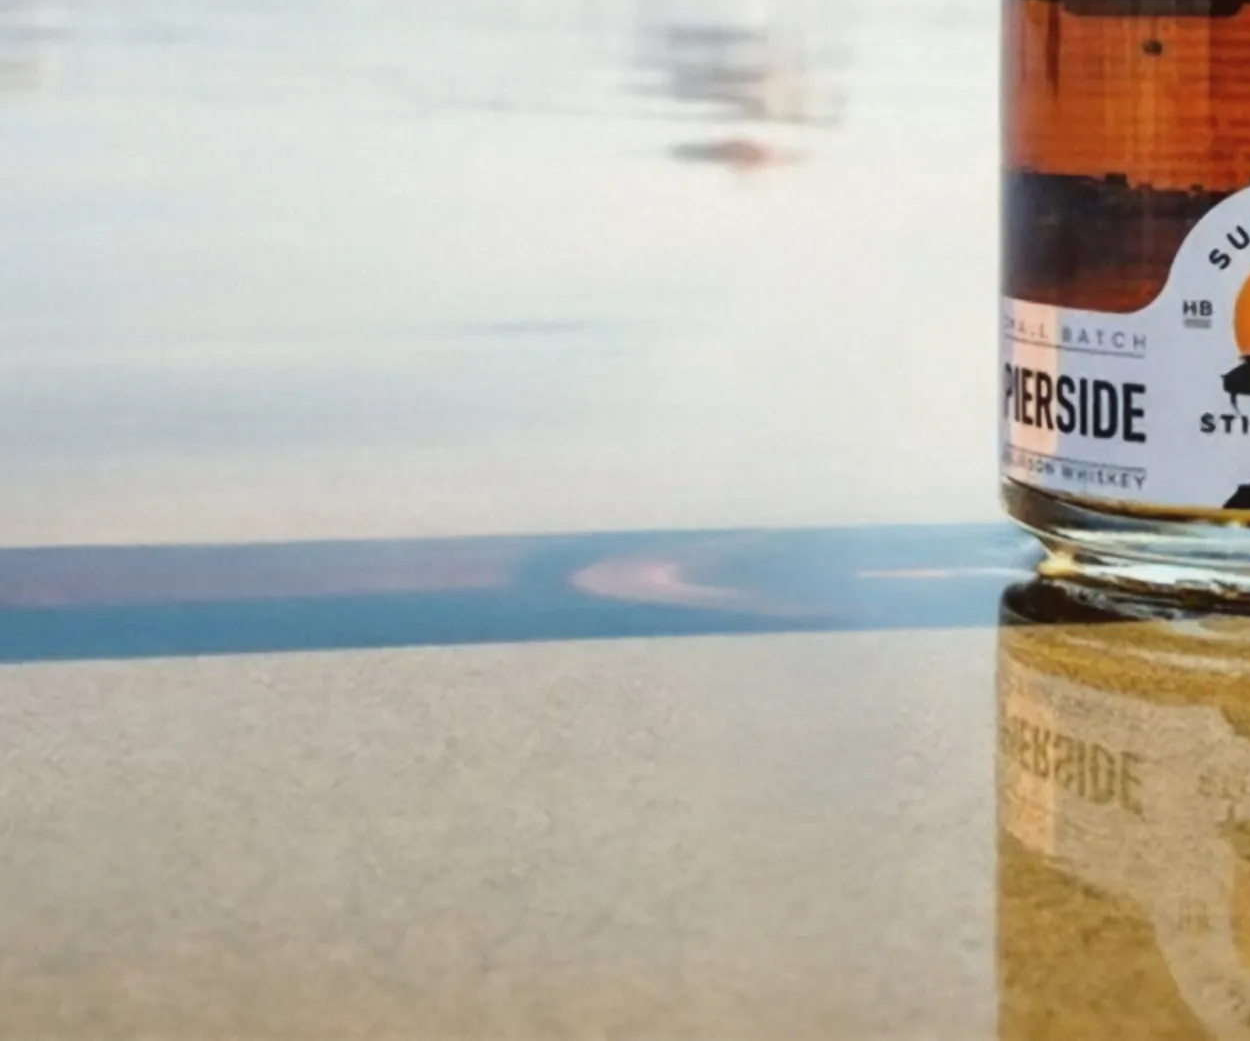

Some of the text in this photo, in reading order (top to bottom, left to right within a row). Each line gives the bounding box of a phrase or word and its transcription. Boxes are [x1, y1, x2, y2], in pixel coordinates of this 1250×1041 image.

[1182, 299, 1213, 317] HB
[1061, 325, 1147, 351] BATCH
[1003, 362, 1147, 443] PIERSIDE
[1061, 464, 1147, 491] WHISKEY
